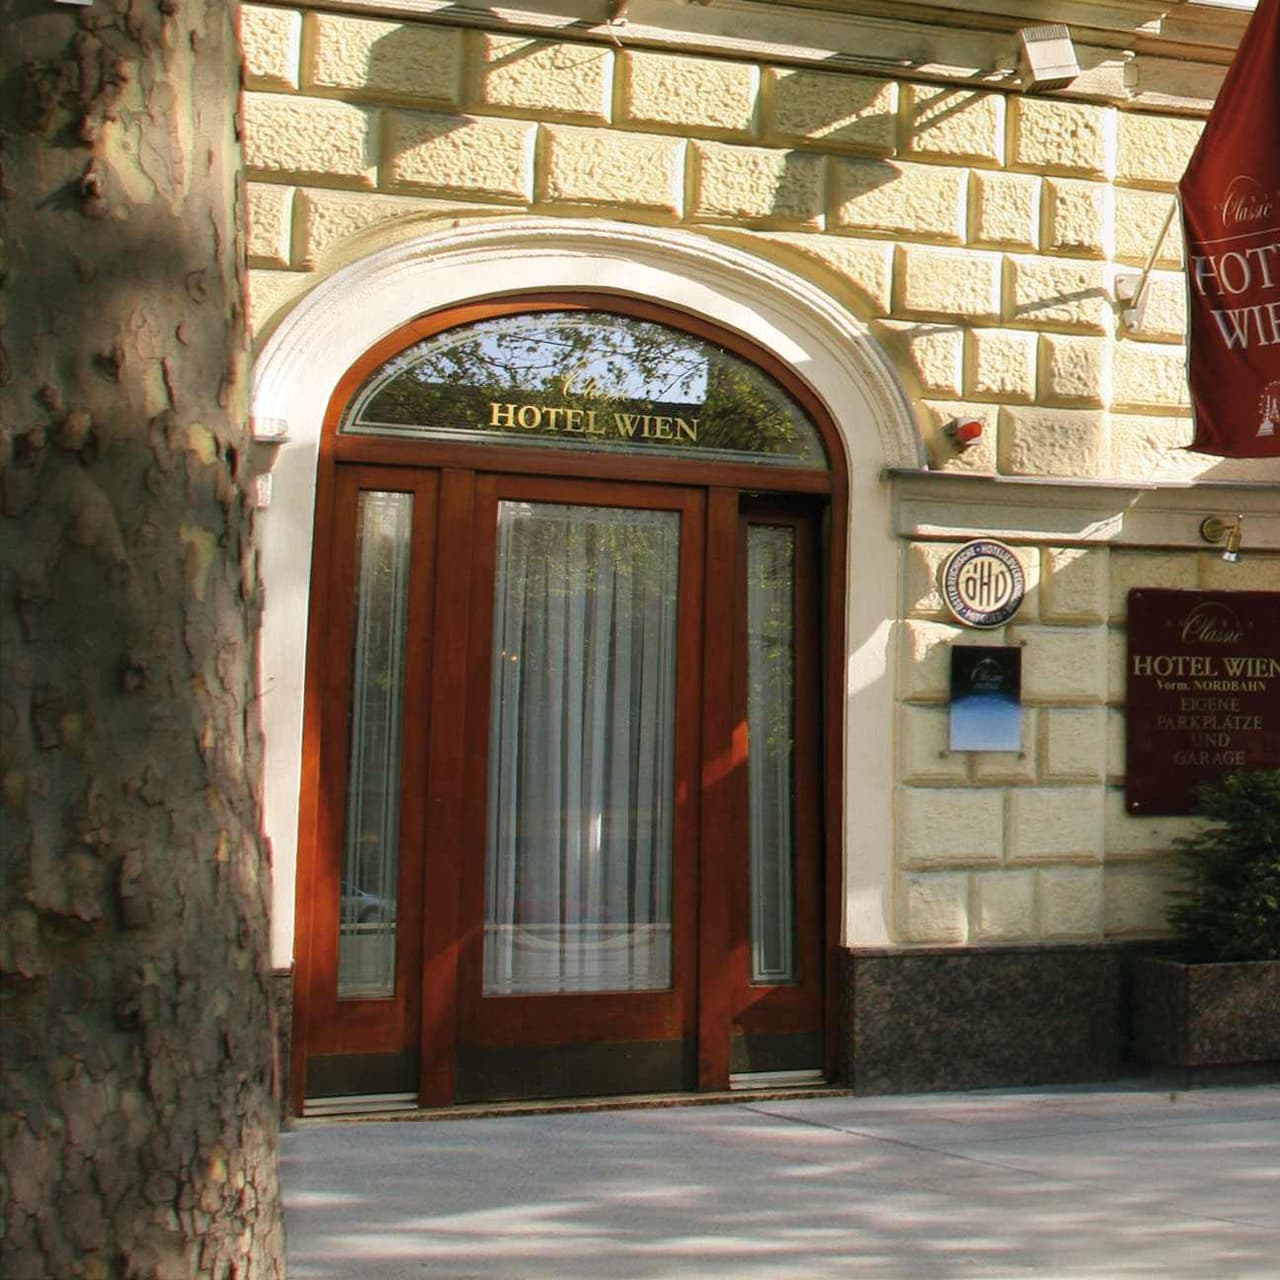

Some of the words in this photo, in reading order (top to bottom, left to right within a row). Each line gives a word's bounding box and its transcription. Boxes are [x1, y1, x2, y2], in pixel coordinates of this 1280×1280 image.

[1222, 191, 1274, 227] Classic
[489, 402, 605, 435] HOTEL
[613, 412, 700, 442] WIEN
[1181, 615, 1244, 645] Classic
[1133, 655, 1218, 677] HOTEL
[1156, 679, 1190, 691] Vorm.
[1194, 680, 1266, 692] NORDBAHN
[1181, 697, 1240, 713] EIGENE
[1192, 732, 1231, 748] UND
[1174, 751, 1246, 766] GARAGE
